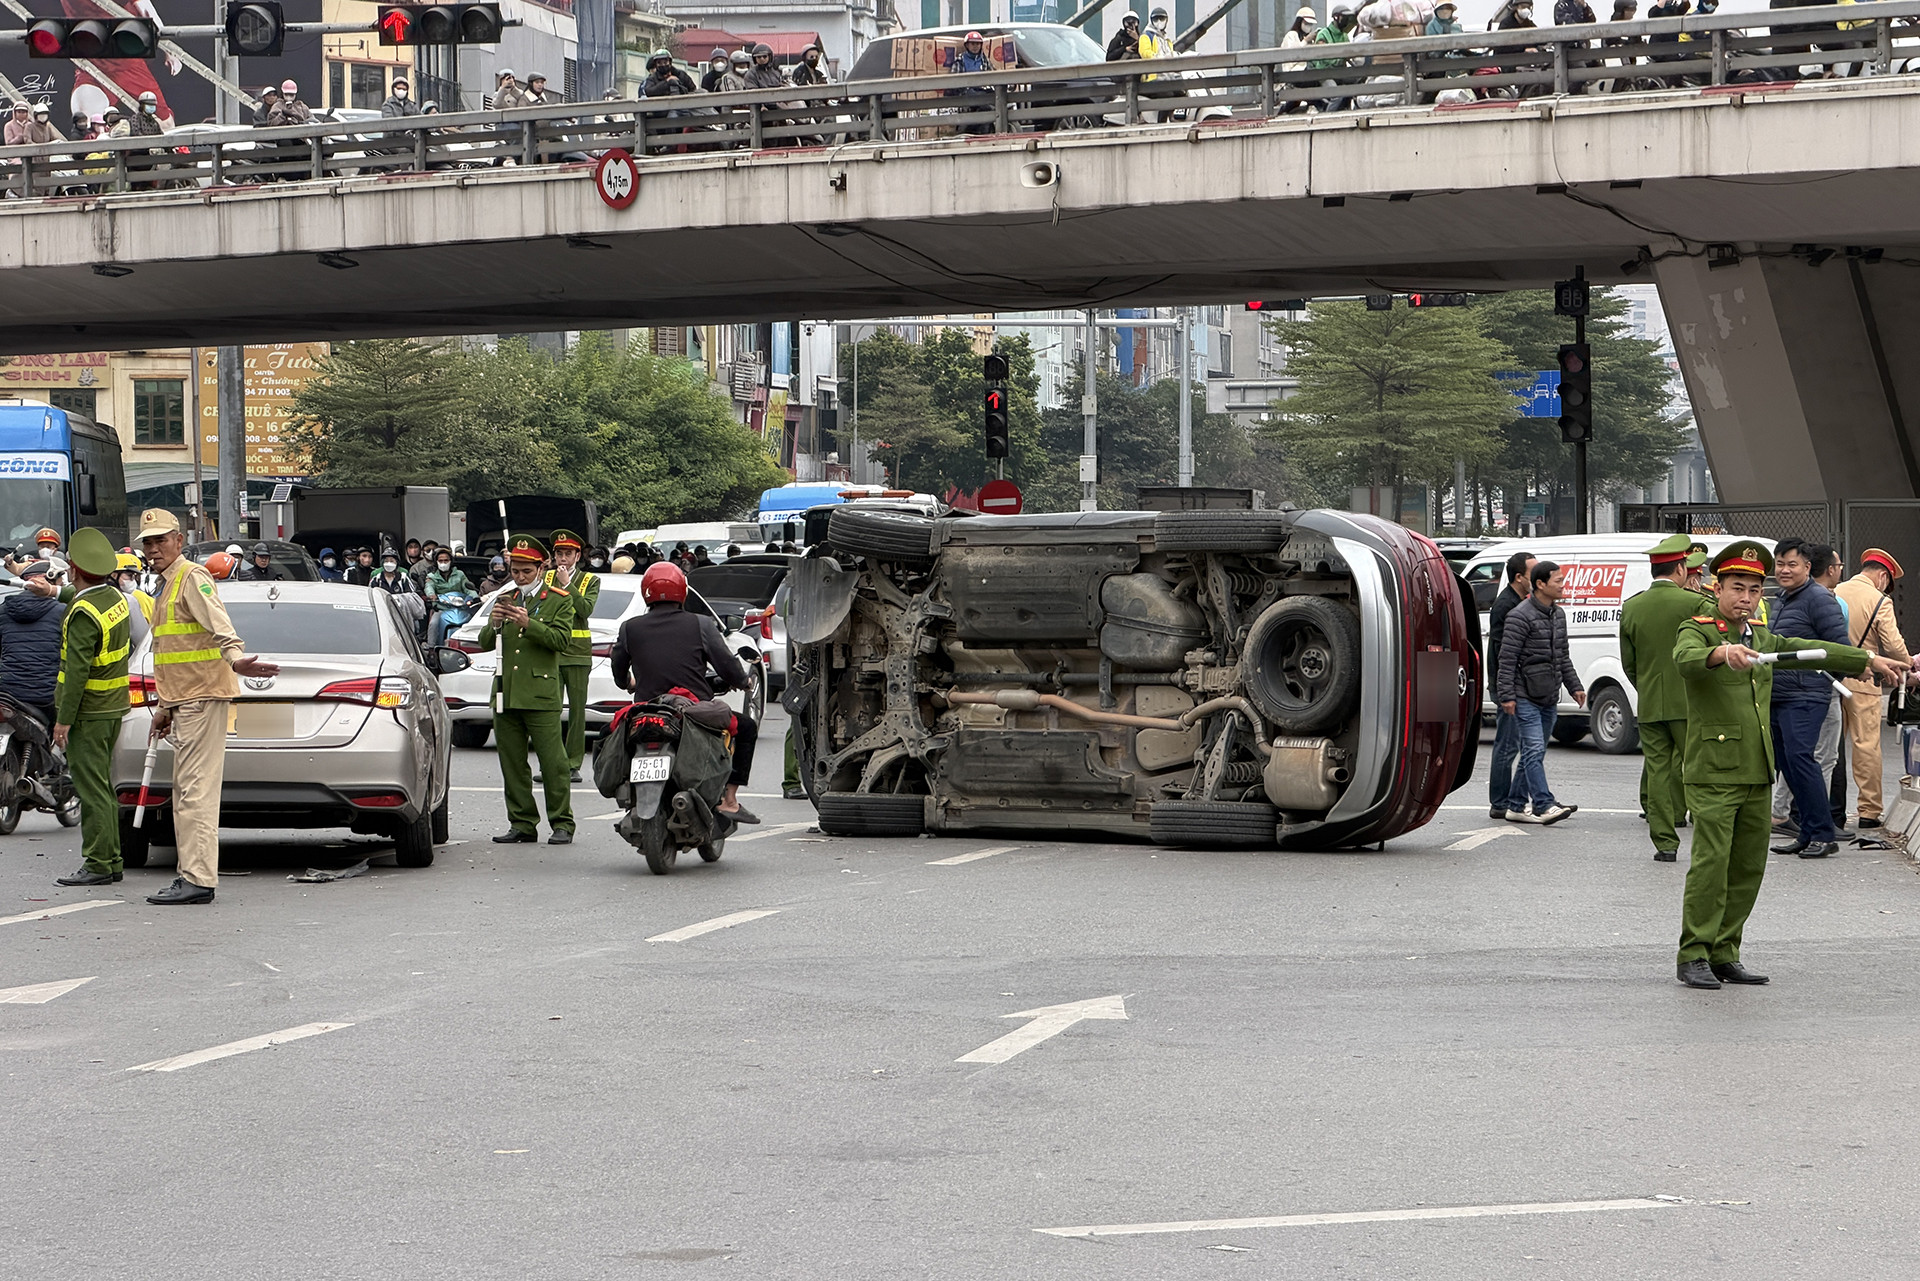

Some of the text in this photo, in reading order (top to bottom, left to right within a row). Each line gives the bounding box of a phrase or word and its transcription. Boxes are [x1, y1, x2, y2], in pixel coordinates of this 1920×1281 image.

[607, 168, 628, 193] 4,75m
[1562, 567, 1626, 587] AMOVE
[1572, 609, 1622, 624] 18H-040.16
[633, 769, 667, 780] 264.00
